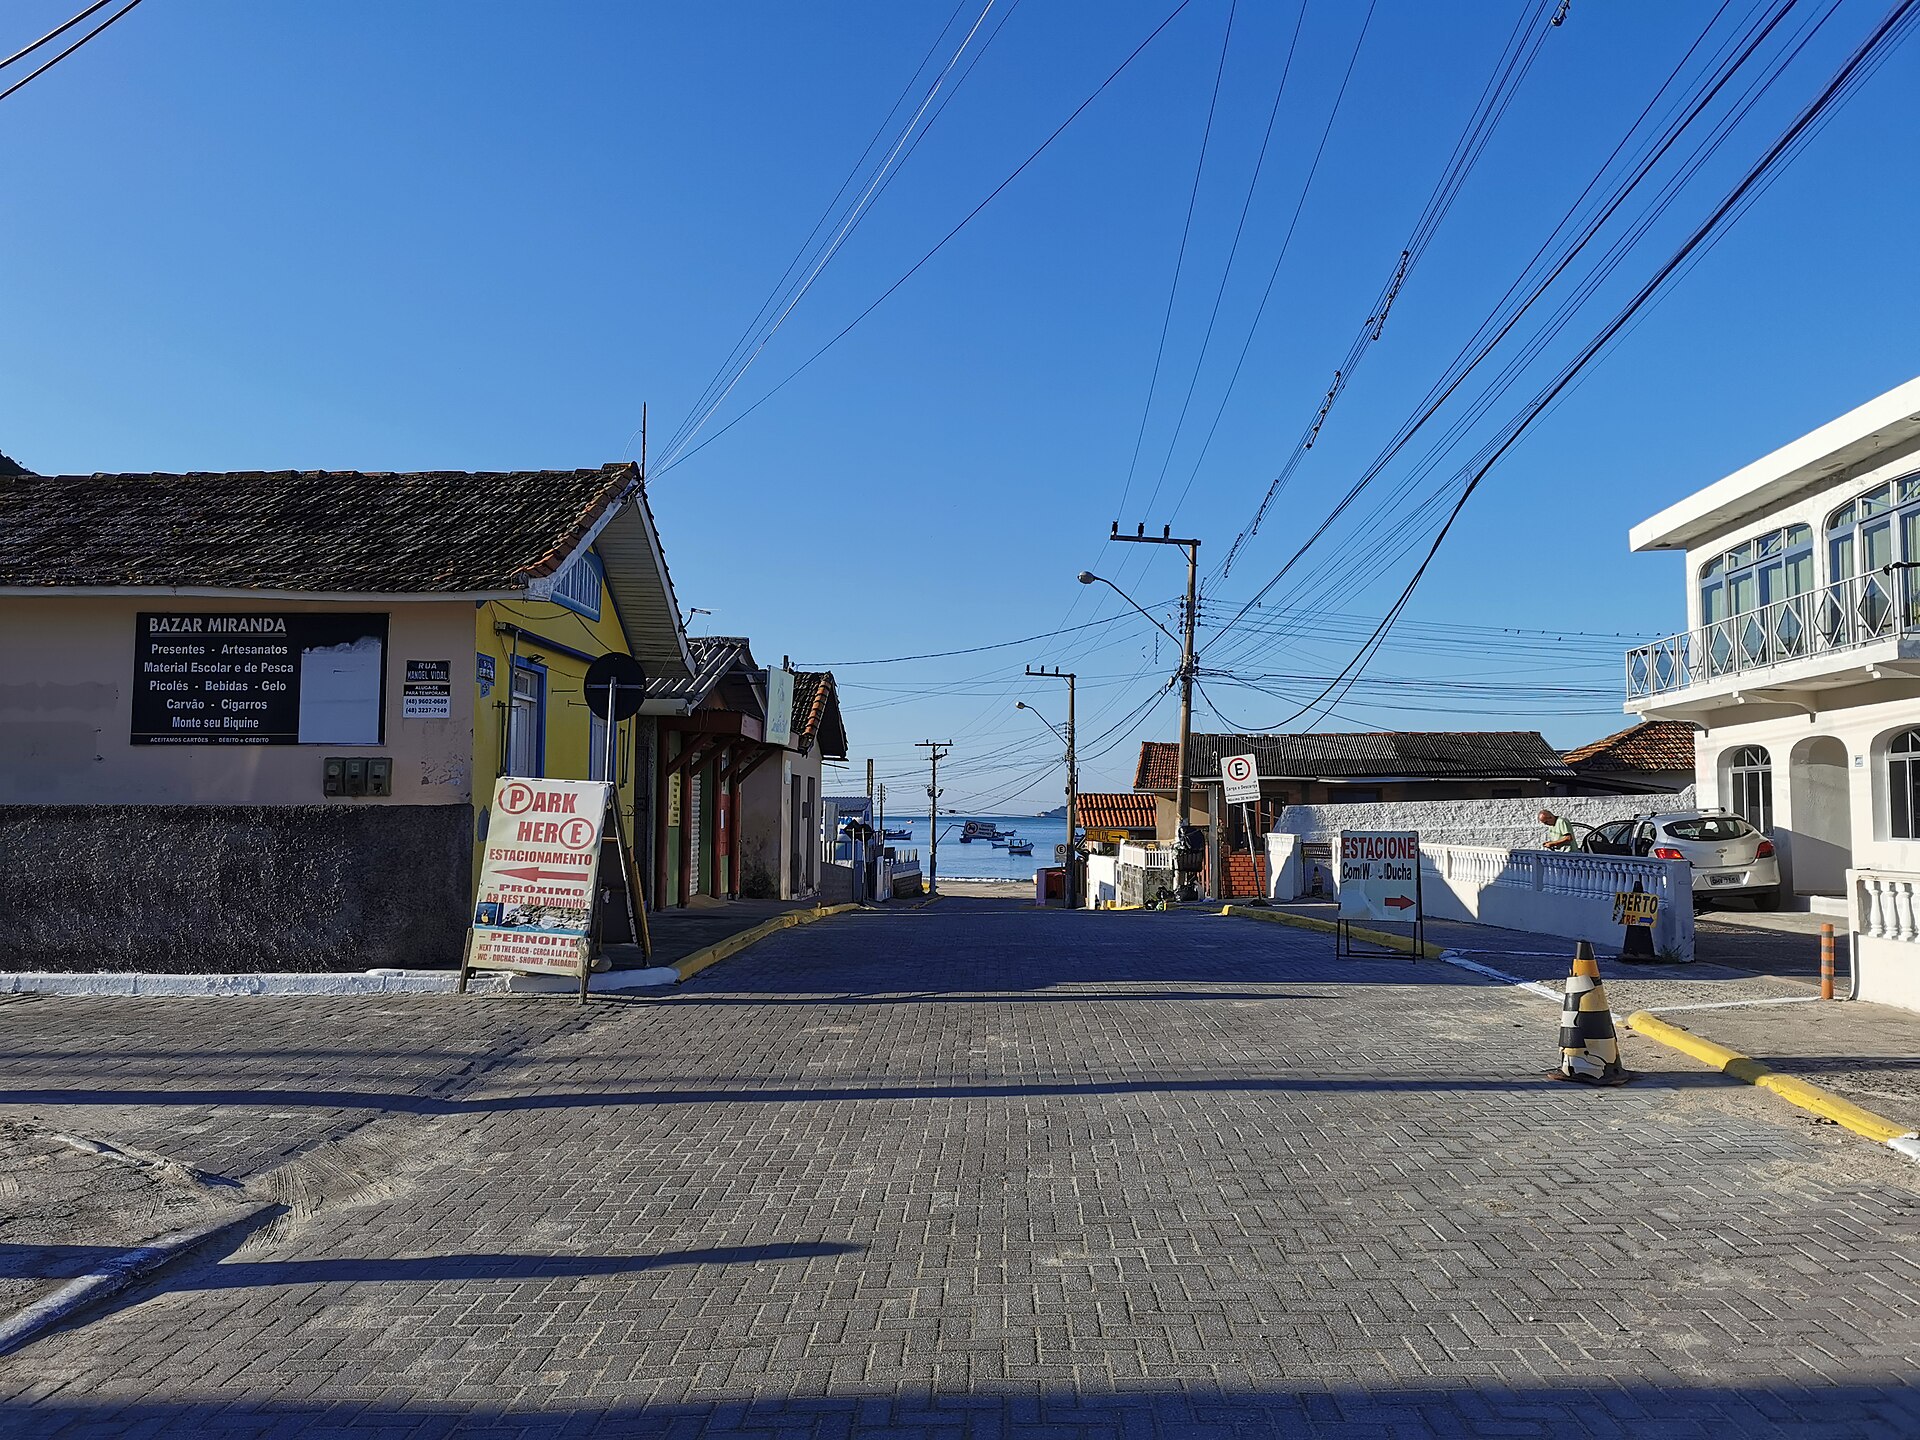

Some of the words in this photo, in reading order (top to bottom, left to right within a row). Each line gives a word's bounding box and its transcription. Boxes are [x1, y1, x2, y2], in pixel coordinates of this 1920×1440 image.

[149, 618, 202, 632] BAZAR
[208, 618, 286, 632] MIRANDA
[151, 644, 205, 655] Presentes
[221, 644, 288, 655] Artesanatos
[144, 662, 188, 673] Material
[190, 662, 232, 673] Escolar
[234, 664, 241, 673] e
[244, 662, 258, 673] de
[261, 662, 294, 673] Pesca
[407, 671, 428, 680] MANOEL
[431, 671, 447, 680] VIDAL
[150, 680, 188, 691] Picolés
[205, 680, 248, 691] Bebidas
[261, 681, 286, 691] Gelo
[166, 699, 204, 709] Carvão
[221, 699, 267, 711] Cigarros
[172, 717, 201, 728] Monte
[204, 719, 220, 728] seu
[223, 717, 259, 730] Biquine
[1234, 763, 1244, 776] E
[510, 790, 578, 813] PARK
[517, 821, 582, 844] HERE
[1342, 837, 1415, 859] ESTACIONE
[489, 848, 593, 865] ESTACIONAMENTO
[499, 884, 584, 897] PRÓXIMO
[528, 895, 540, 904] DO
[543, 896, 586, 908] VADINHO
[512, 945, 529, 955] BEACH
[533, 947, 550, 958] CERCA
[520, 956, 543, 965] SHOWER
